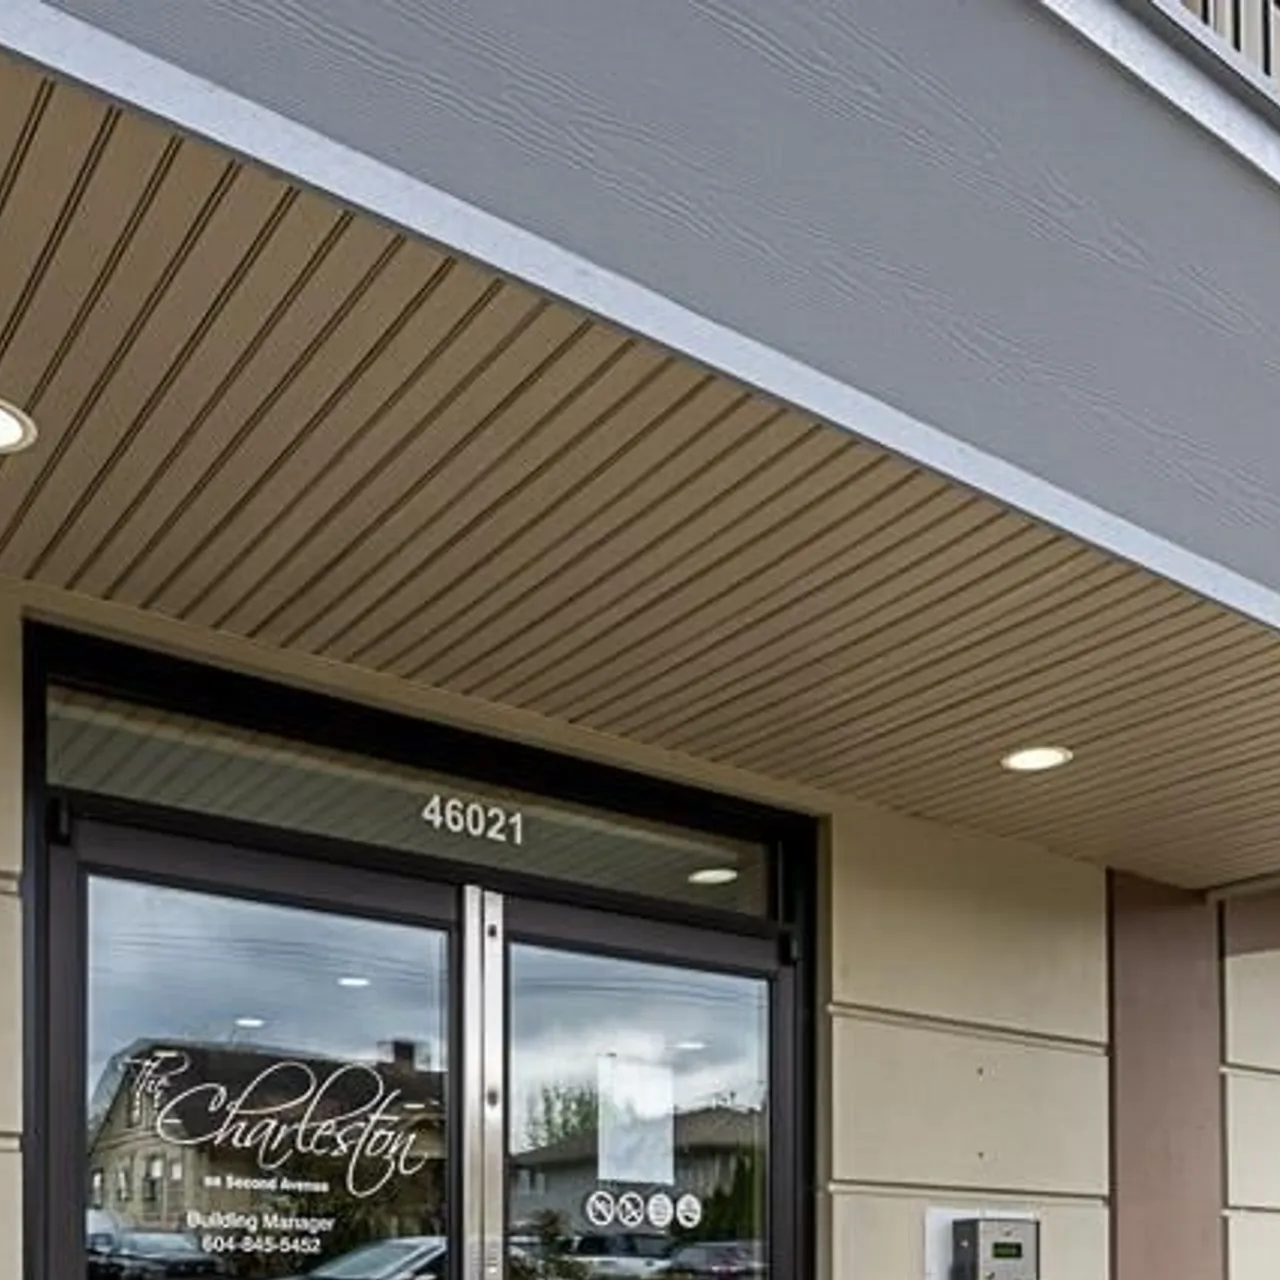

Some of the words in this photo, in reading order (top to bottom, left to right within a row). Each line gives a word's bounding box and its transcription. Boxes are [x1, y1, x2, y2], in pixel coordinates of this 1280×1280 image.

[422, 794, 523, 845] 46021
[157, 1062, 427, 1198] Charleston
[226, 1174, 277, 1190] Second
[186, 1210, 258, 1233] Building
[262, 1213, 336, 1234] Manager
